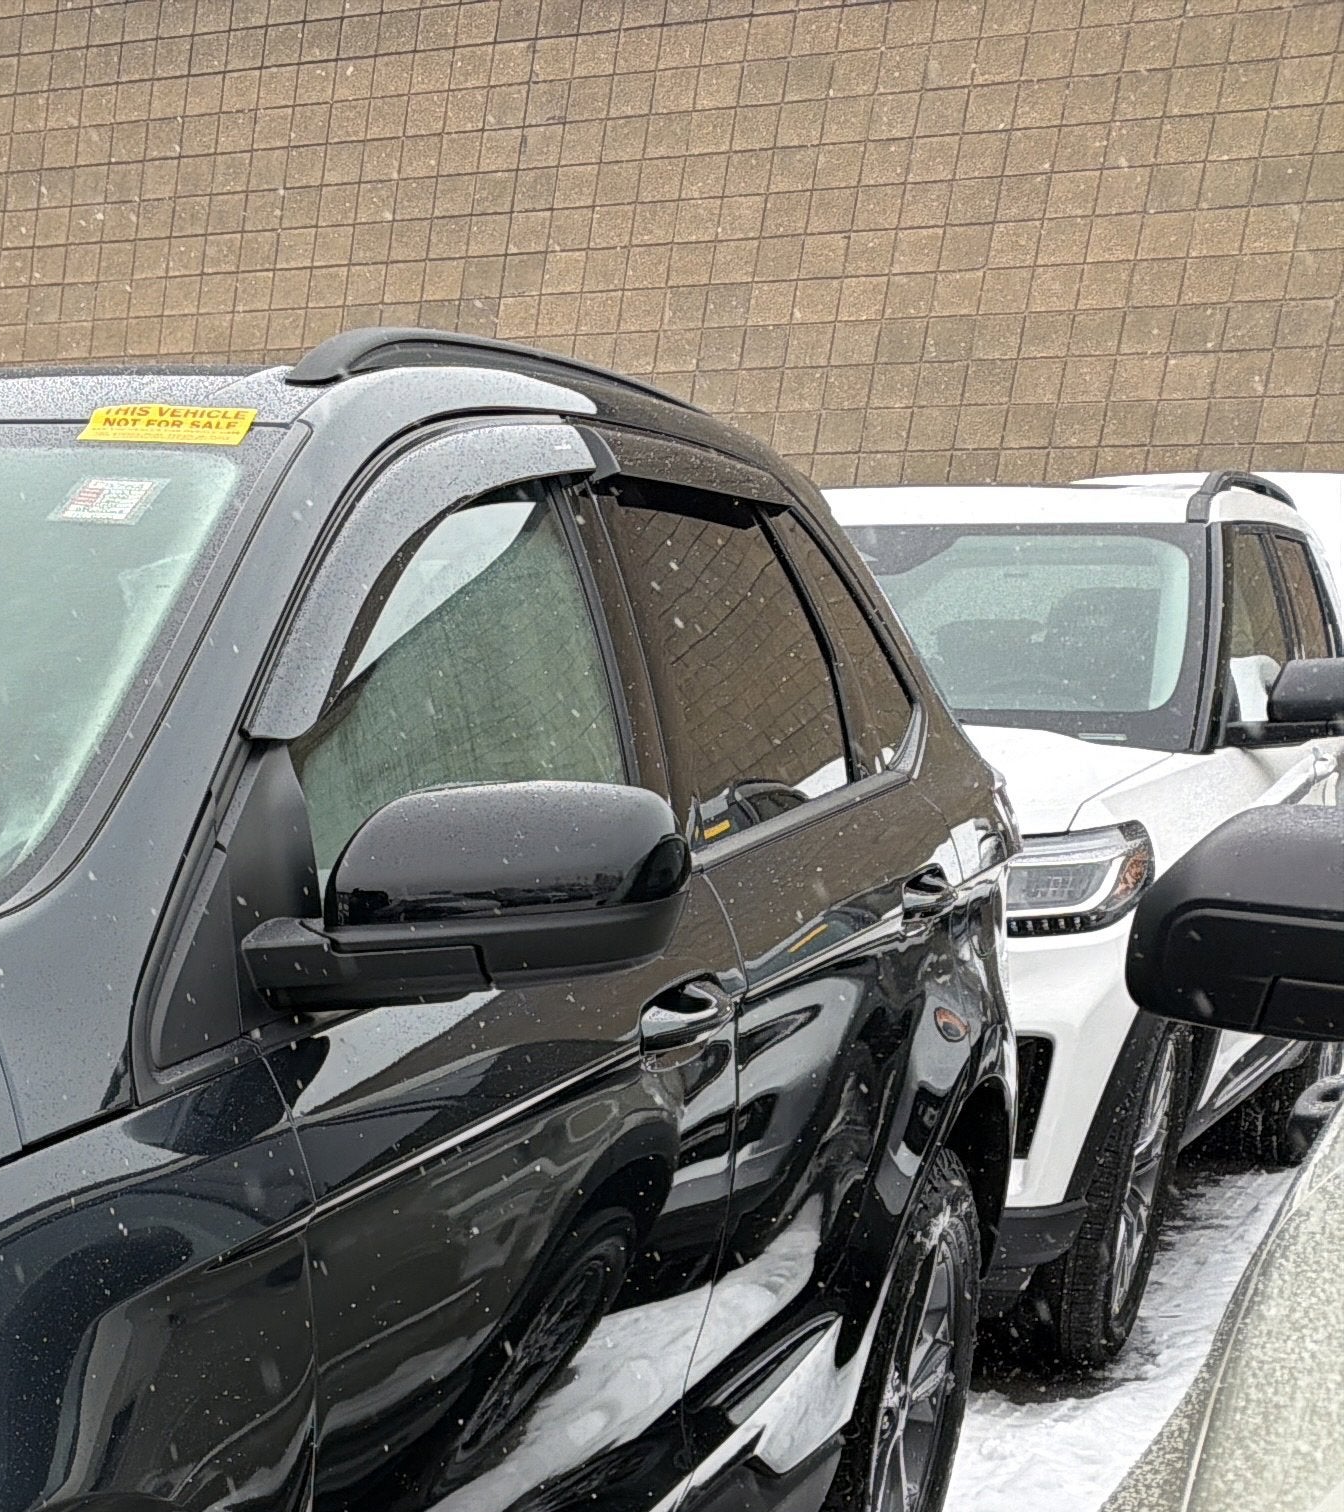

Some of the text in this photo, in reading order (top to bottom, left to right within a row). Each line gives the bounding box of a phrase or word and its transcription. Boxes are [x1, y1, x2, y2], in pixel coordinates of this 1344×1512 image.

[158, 405, 249, 420] VEHICLE
[102, 417, 141, 427] NOT
[145, 419, 183, 428] FOR
[190, 420, 238, 430] SALE
